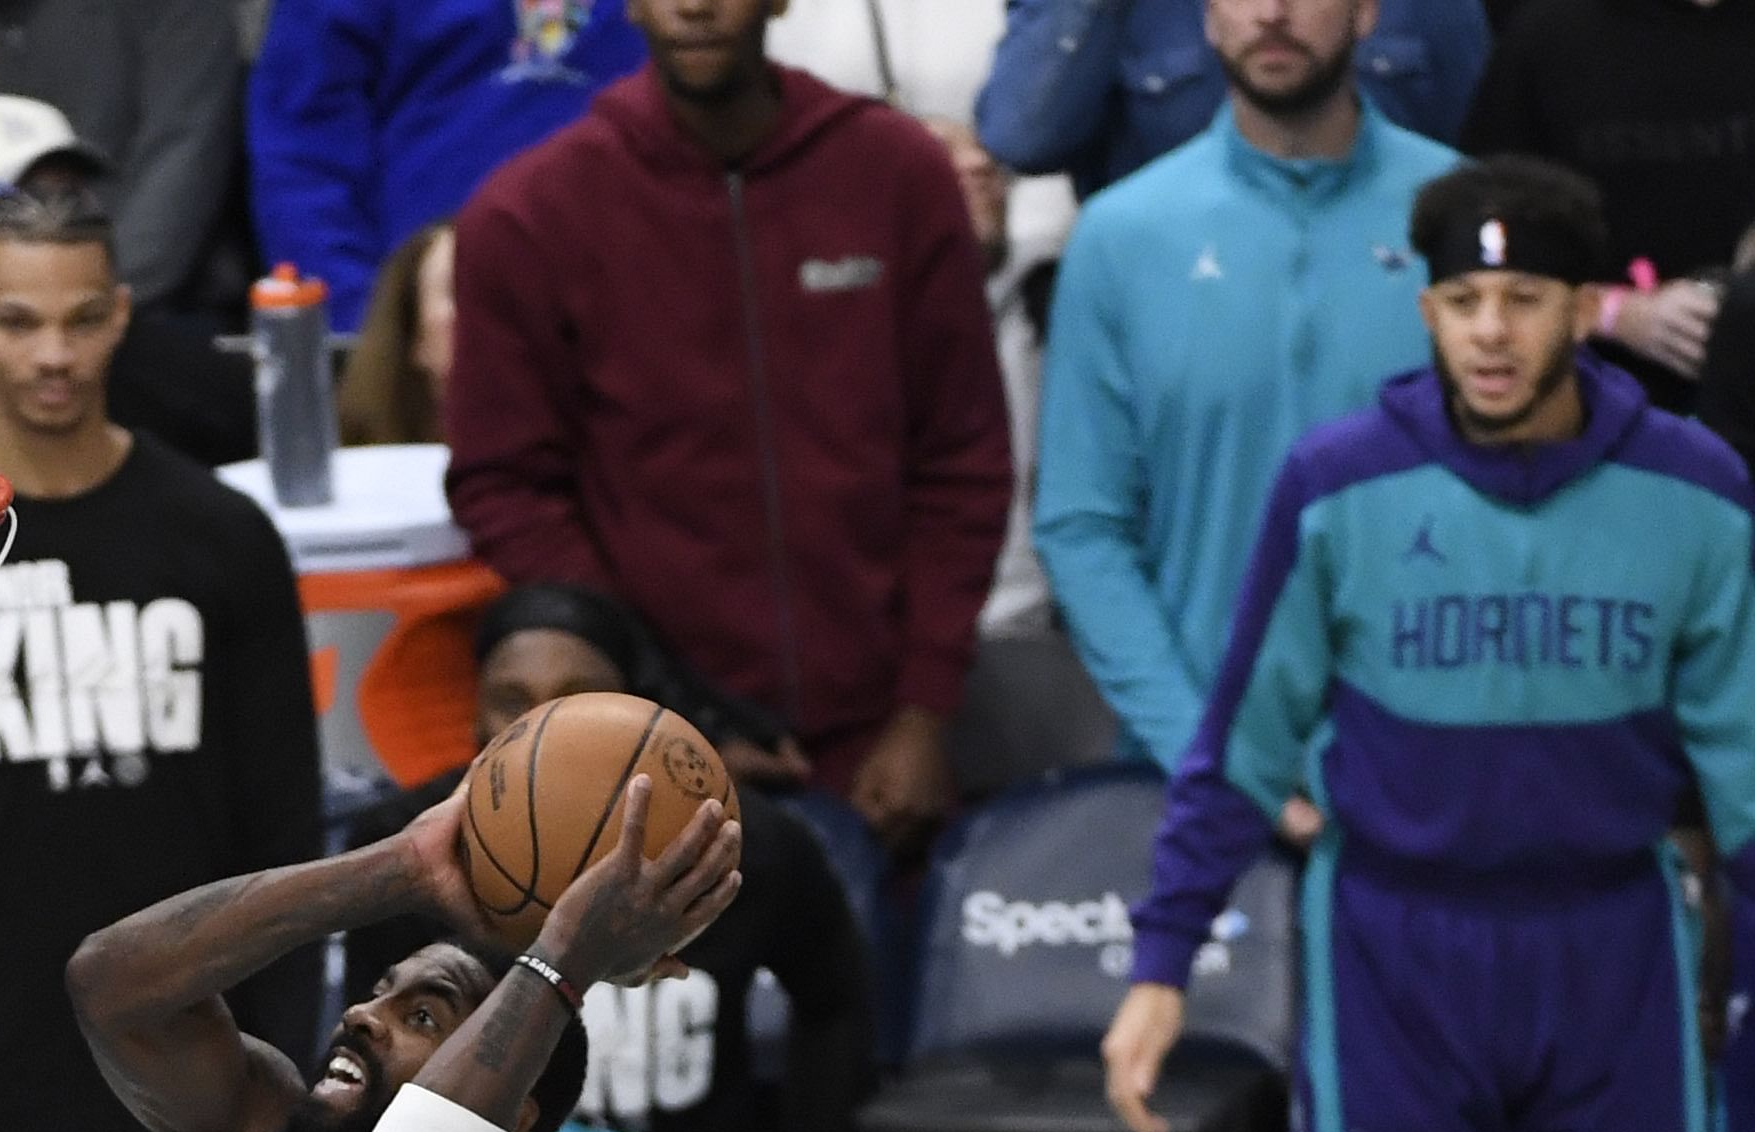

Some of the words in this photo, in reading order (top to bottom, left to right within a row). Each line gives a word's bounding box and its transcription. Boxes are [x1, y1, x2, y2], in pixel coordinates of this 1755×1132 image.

[1391, 592, 1654, 671] HORNETS
[961, 891, 1133, 956] Spect
[580, 968, 719, 1118] NG
